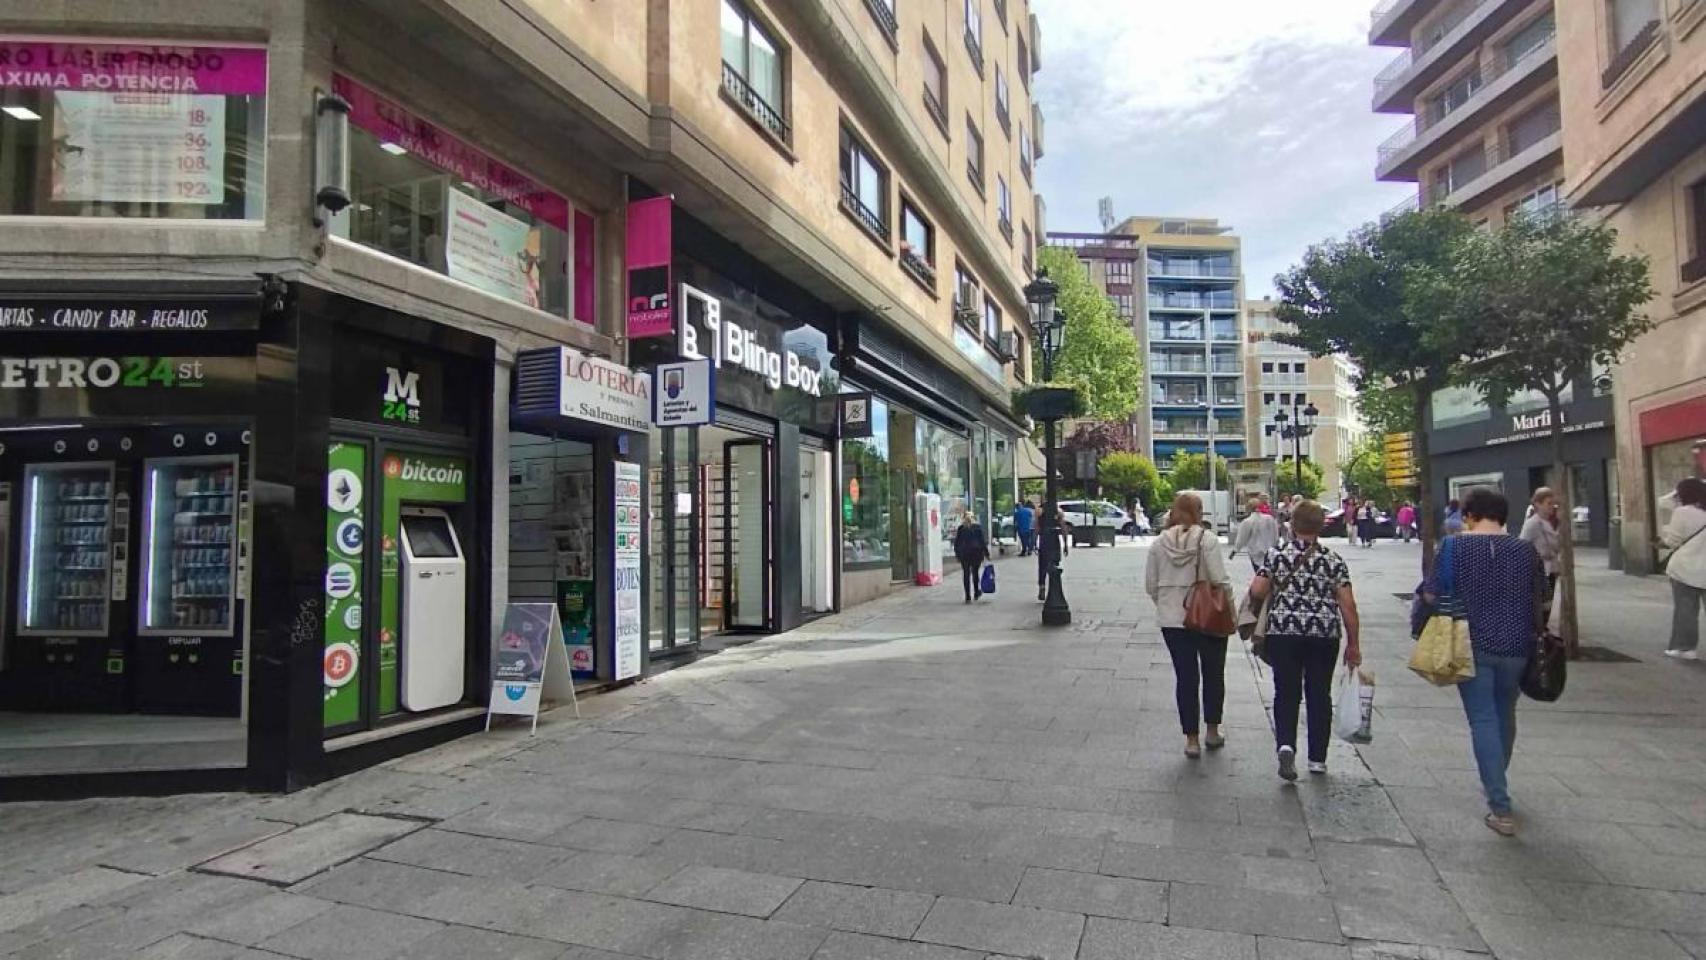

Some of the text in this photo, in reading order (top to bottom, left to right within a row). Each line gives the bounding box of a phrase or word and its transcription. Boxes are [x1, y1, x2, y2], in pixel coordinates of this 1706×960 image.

[81, 73, 198, 90] POTENCIA
[53, 308, 102, 328] CANDY
[109, 309, 136, 328] BAR
[151, 309, 208, 328] REGALOS
[725, 321, 821, 397] Bling Box
[384, 366, 420, 406] M
[566, 354, 648, 399] LOTERIA
[580, 402, 648, 430] Salmantina
[401, 458, 463, 484] bitcoin
